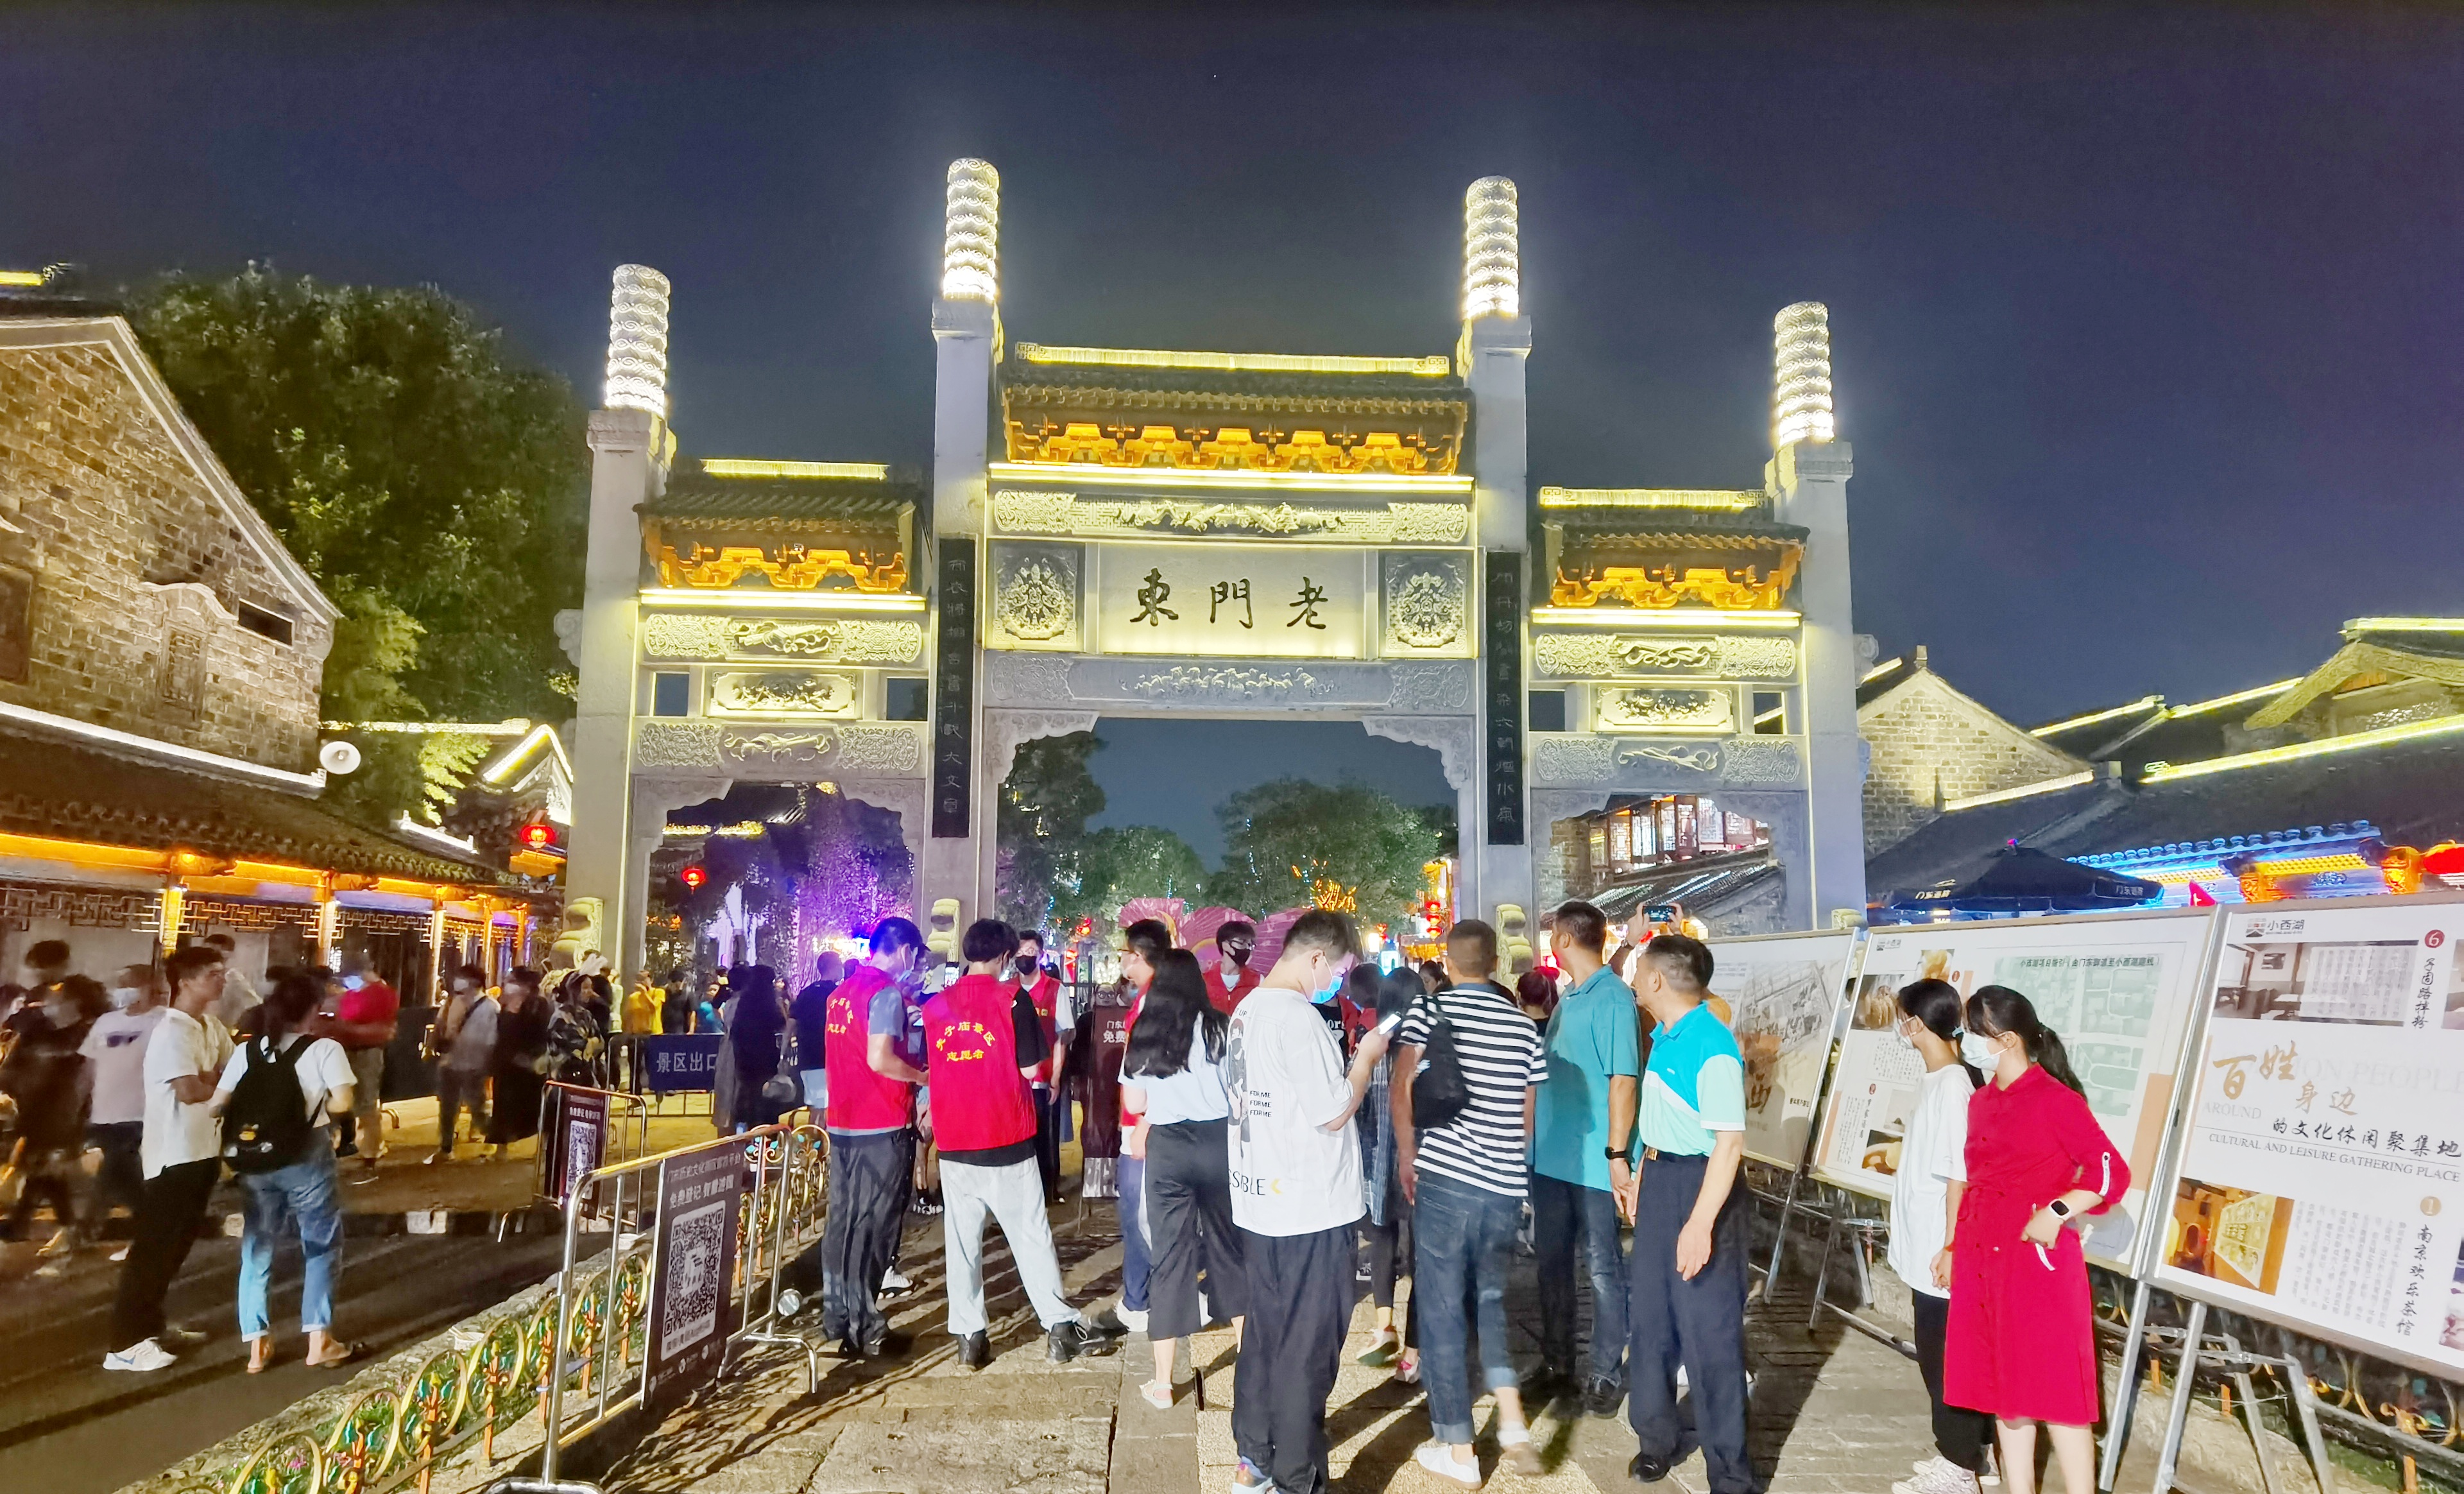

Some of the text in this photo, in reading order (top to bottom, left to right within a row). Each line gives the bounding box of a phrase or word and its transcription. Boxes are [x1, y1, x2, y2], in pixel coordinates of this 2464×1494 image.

[2267, 920, 2304, 931] 小西湖
[2429, 932, 2440, 947] 6
[936, 1021, 996, 1052] 夫子庙景区
[1107, 1020, 1125, 1029] 门东
[656, 1051, 718, 1073] 景区出口
[946, 1049, 984, 1062] 志愿者
[2212, 1040, 2298, 1100] 百姓
[2295, 1081, 2358, 1115] 身边
[2273, 1117, 2461, 1158] 的文化休闲聚集地
[2209, 1133, 2461, 1182] CULTURAL AND LEISURE GATHERING PLACE
